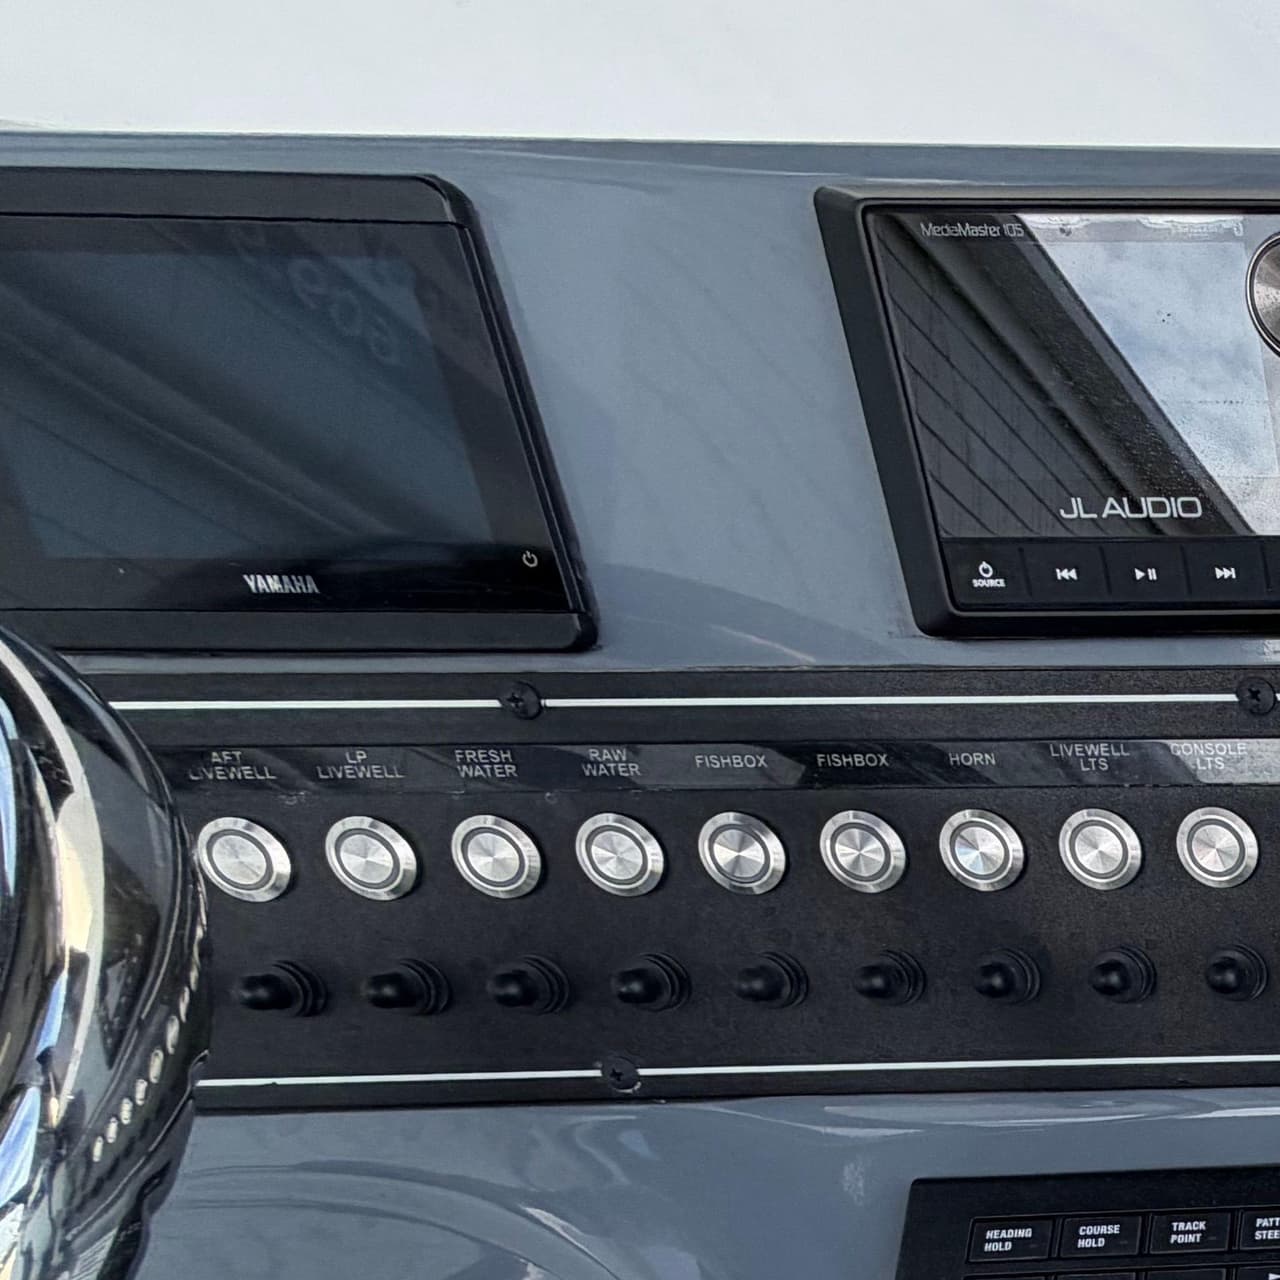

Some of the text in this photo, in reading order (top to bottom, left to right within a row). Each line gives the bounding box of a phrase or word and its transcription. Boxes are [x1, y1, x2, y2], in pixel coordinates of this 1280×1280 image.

[920, 222, 1025, 238] MediaMaster 105
[1059, 496, 1203, 519] JL AUDIO
[242, 574, 320, 594] YAMAHA
[972, 578, 1006, 588] SOURCE
[455, 749, 513, 763] FRESH
[588, 748, 627, 762] RAW
[1049, 743, 1131, 757] LIVEWELL
[1169, 742, 1249, 756] CONSOLE
[211, 751, 243, 763] AFT
[345, 750, 368, 764] LP
[695, 755, 768, 769] FISHBOX
[817, 753, 889, 768] FISHBOX
[949, 752, 997, 766] HORN
[1196, 756, 1225, 770] LTS
[317, 765, 405, 779] LIVEWELL
[456, 764, 518, 778] WATER
[582, 763, 642, 777] WATER
[1080, 758, 1109, 772] LTS
[1078, 1224, 1121, 1236] COURSE
[1171, 1220, 1207, 1232] TRACK
[985, 1228, 1033, 1240] HEADING
[1170, 1233, 1202, 1244] POINT
[984, 1241, 1013, 1252] HOLD
[1077, 1237, 1106, 1248] HOLD
